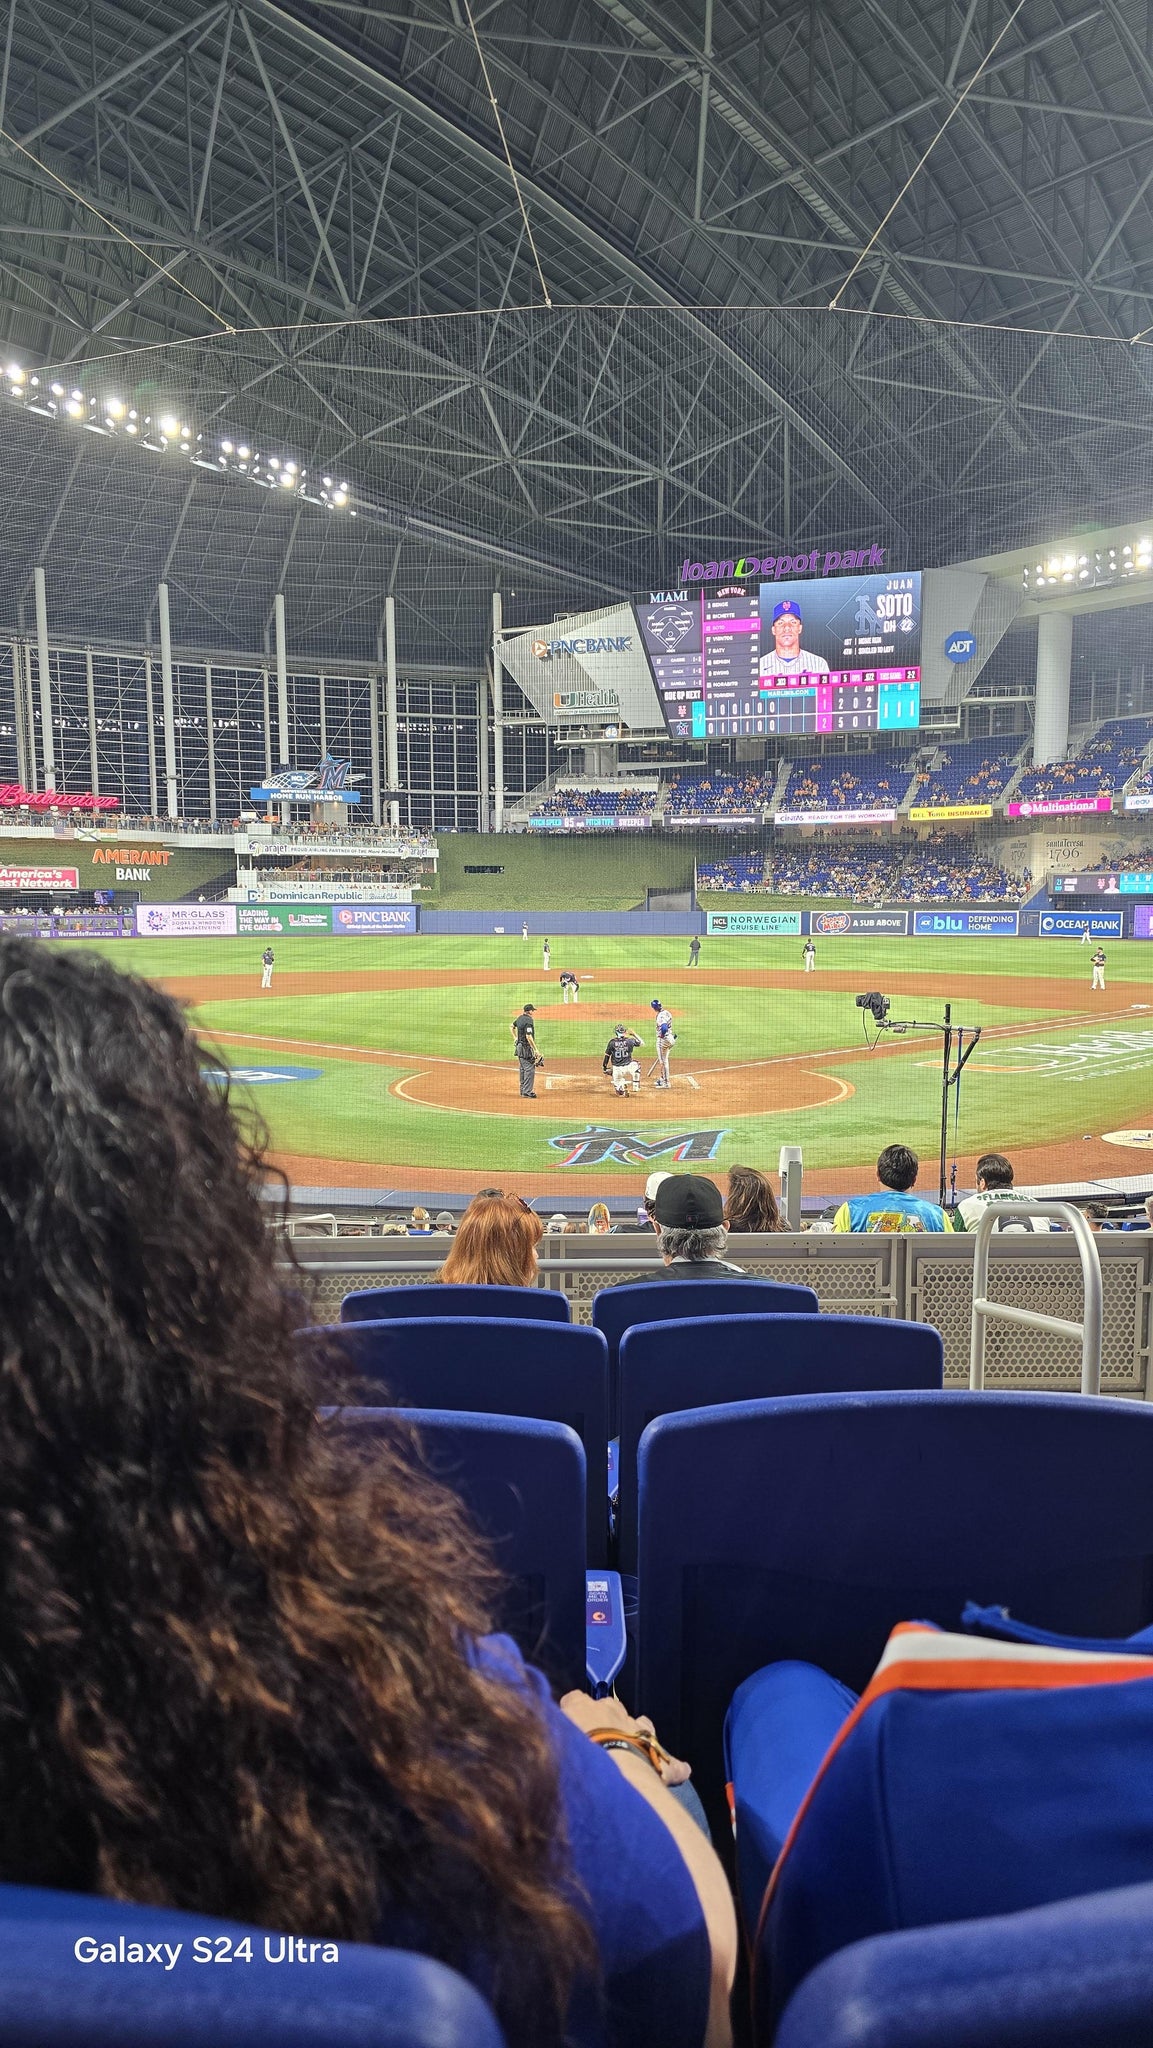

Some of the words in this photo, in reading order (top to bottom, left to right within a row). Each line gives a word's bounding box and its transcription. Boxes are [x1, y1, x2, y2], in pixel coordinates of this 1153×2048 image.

[681, 550, 819, 582] loanDepot
[822, 544, 887, 575] park
[886, 579, 912, 590] JUAN
[650, 590, 688, 603] MIAMI
[717, 588, 730, 598] NEW
[730, 586, 746, 596] YORK
[876, 593, 912, 618] SOTO
[884, 620, 896, 633] DH
[901, 619, 913, 632] 22
[948, 640, 973, 653] ADT
[686, 690, 701, 699] NEXT
[720, 704, 725, 715] 0
[732, 704, 737, 715] 0
[745, 703, 750, 714] 0
[757, 702, 762, 714] 0
[769, 701, 775, 713] 0
[839, 698, 843, 709] 2
[853, 697, 858, 708] 0
[867, 697, 872, 708] 2
[884, 702, 888, 718] 1
[897, 701, 901, 718] 1
[910, 700, 914, 717] 1
[708, 722, 713, 734] 0
[732, 722, 738, 733] 0
[757, 720, 762, 732] 0
[769, 720, 775, 731] 0
[822, 718, 826, 728] 2
[838, 717, 843, 728] 5
[853, 716, 858, 727] 0
[0, 784, 118, 807] Budweiser
[1032, 799, 1097, 814] Multinational
[92, 849, 170, 865] AMERANT
[265, 845, 288, 855] arajet
[411, 848, 428, 859] arajet
[1049, 848, 1079, 862] 1796
[116, 868, 151, 881] BANK
[20, 879, 73, 888] Network
[933, 916, 962, 930] blu
[1056, 920, 1088, 928] OCEAN
[1092, 921, 1119, 929] BANK
